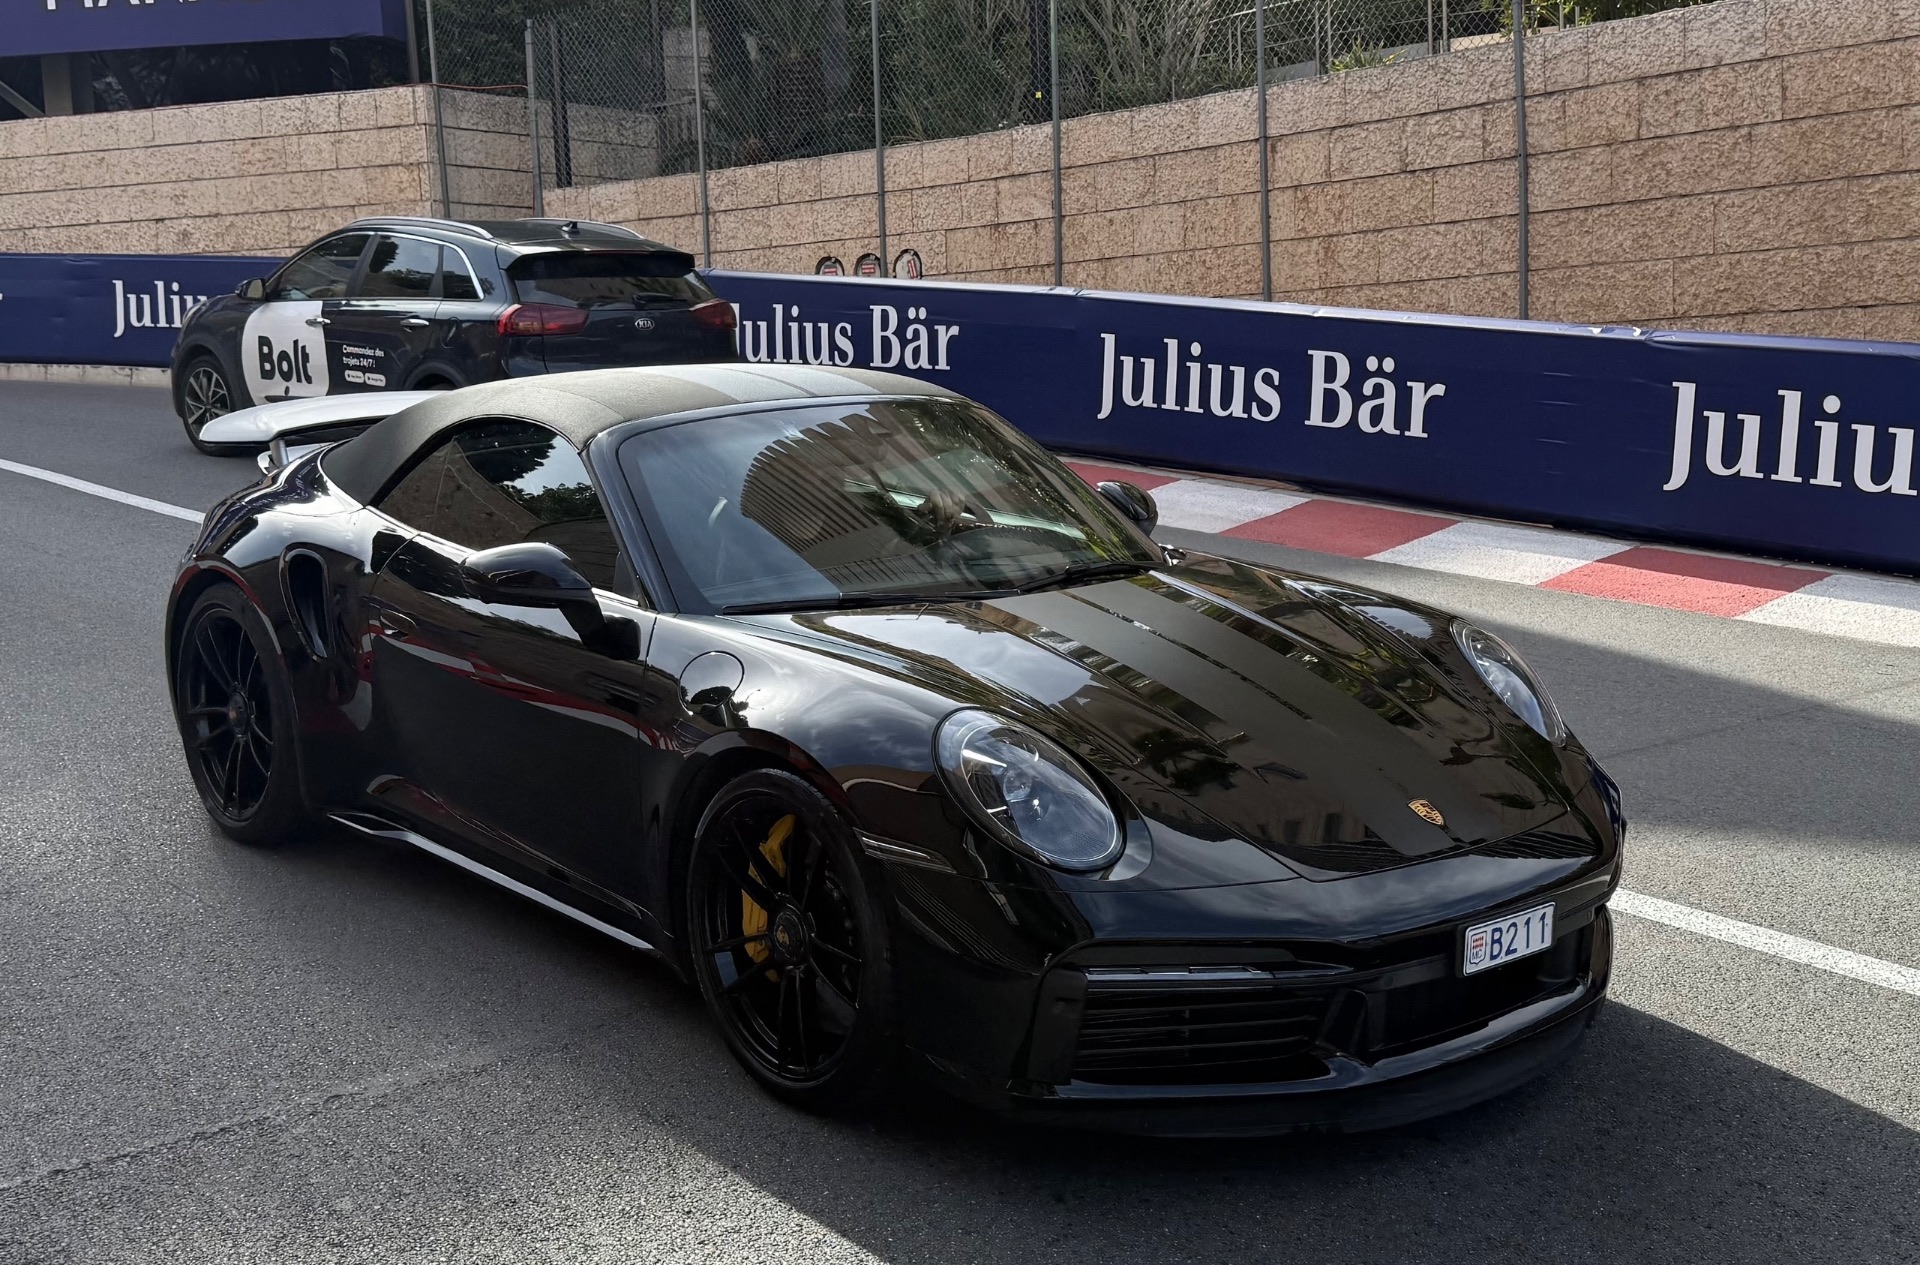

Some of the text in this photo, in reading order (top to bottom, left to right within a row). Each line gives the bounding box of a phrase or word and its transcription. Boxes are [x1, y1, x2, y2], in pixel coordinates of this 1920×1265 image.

[112, 280, 208, 338] Juli
[258, 335, 313, 384] Bolt
[360, 357, 373, 368] 24/7
[375, 347, 385, 357] des
[869, 305, 960, 370] Bär
[1097, 332, 1446, 438] Julius Bär
[1663, 381, 1918, 496] Juliu
[1490, 911, 1547, 961] B211
